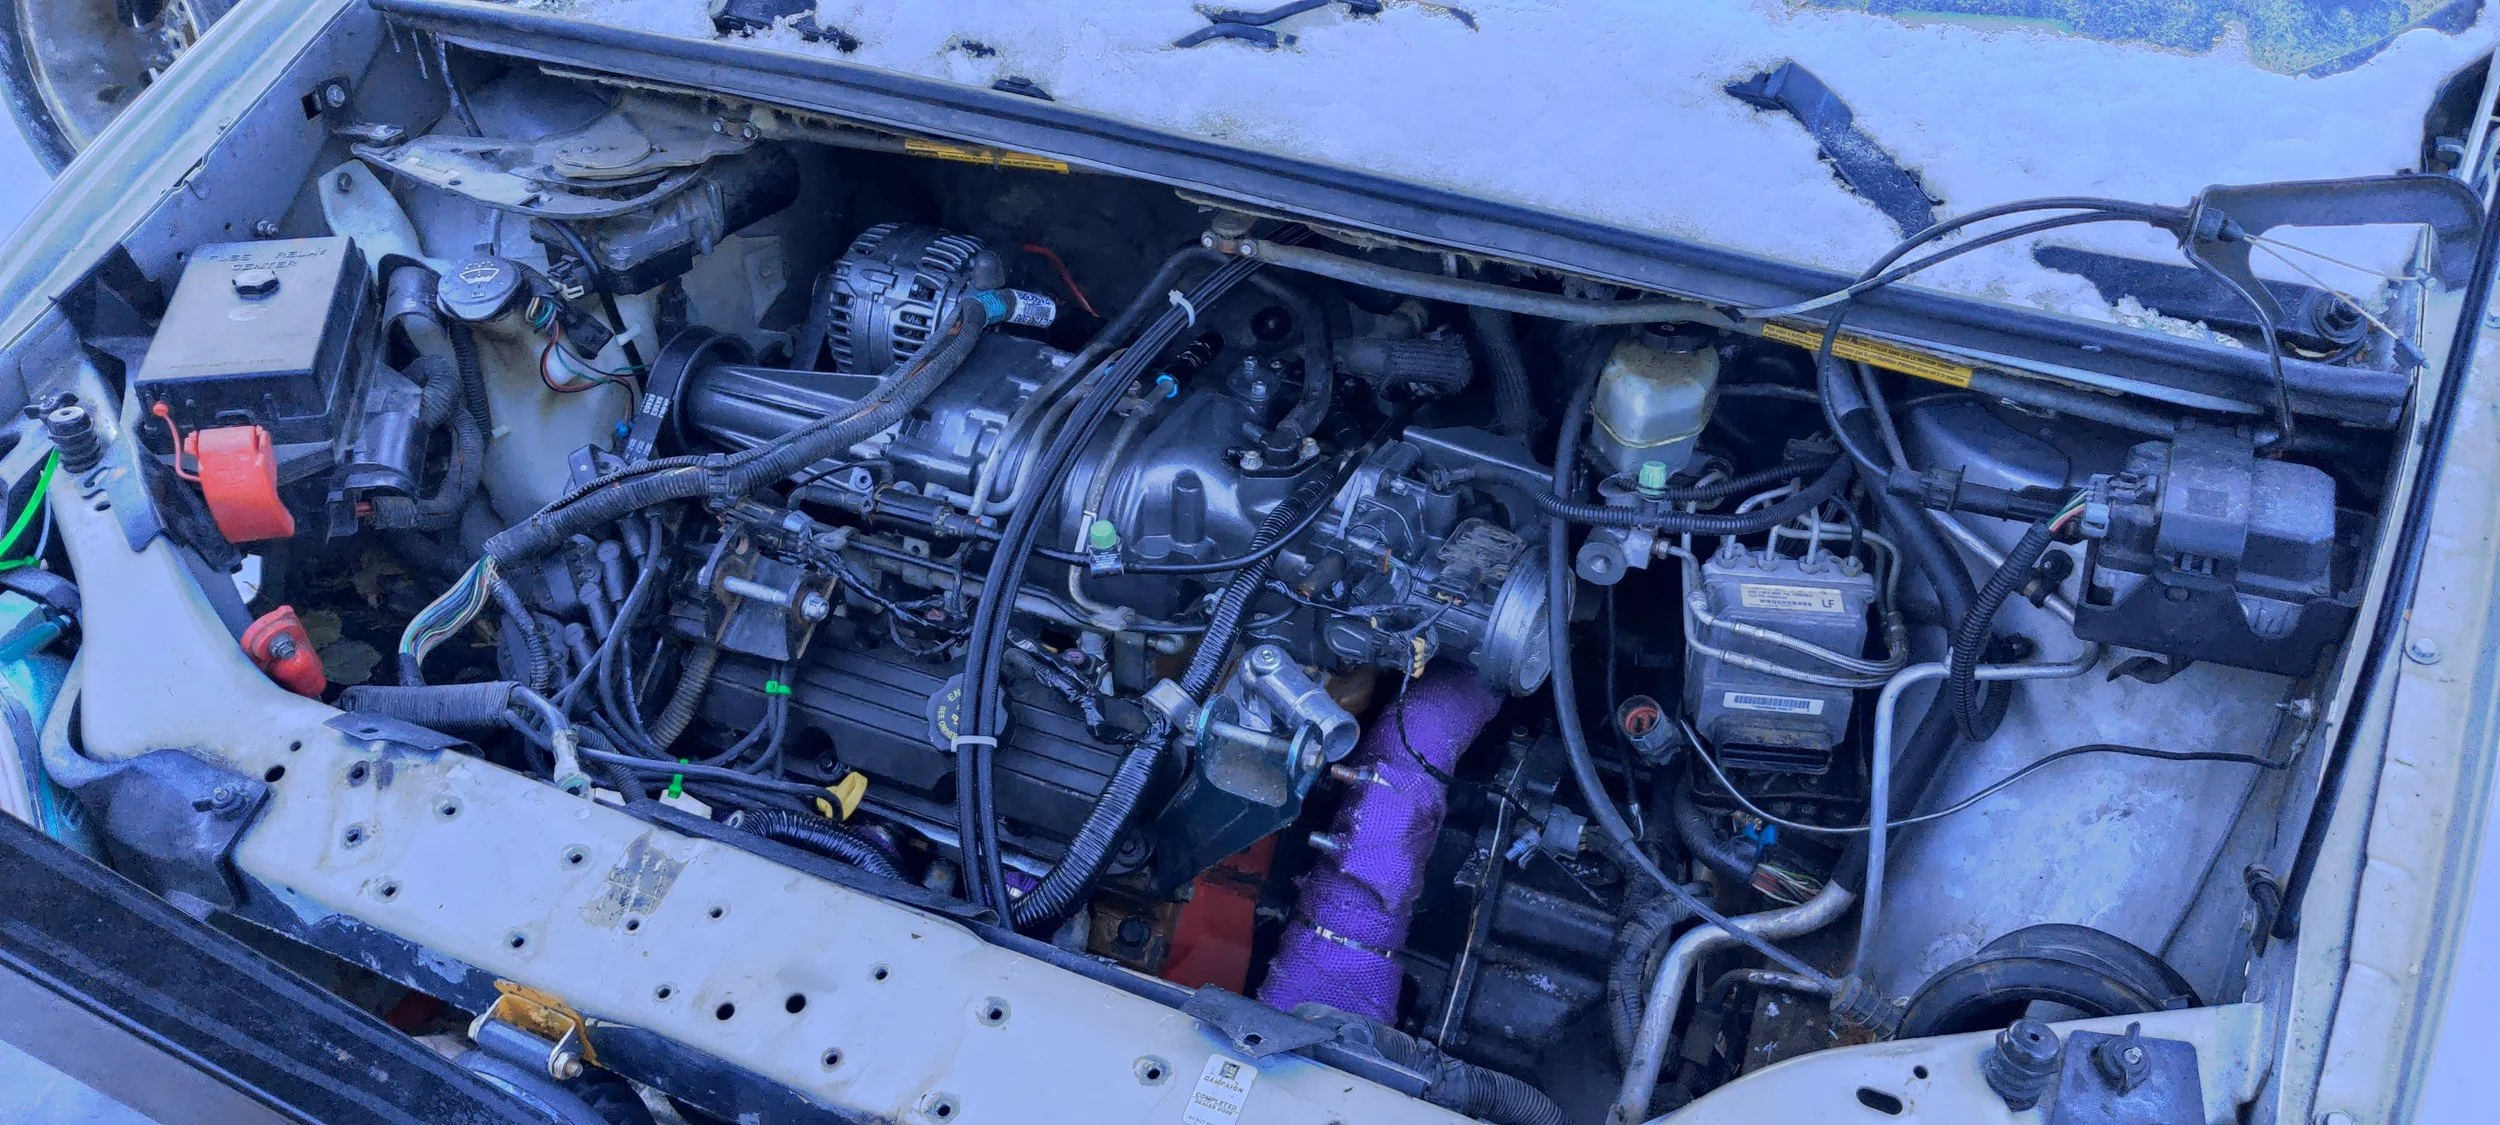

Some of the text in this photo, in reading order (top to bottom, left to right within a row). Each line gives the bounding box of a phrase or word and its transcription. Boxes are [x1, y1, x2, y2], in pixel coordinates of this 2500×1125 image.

[208, 248, 327, 262] FUSE RELAY
[232, 260, 297, 271] CENTER
[1821, 598, 1835, 609] LF
[937, 705, 947, 720] SEE
[1204, 1075, 1244, 1093] CAMPAIGN
[1195, 1092, 1238, 1111] COMPLETED
